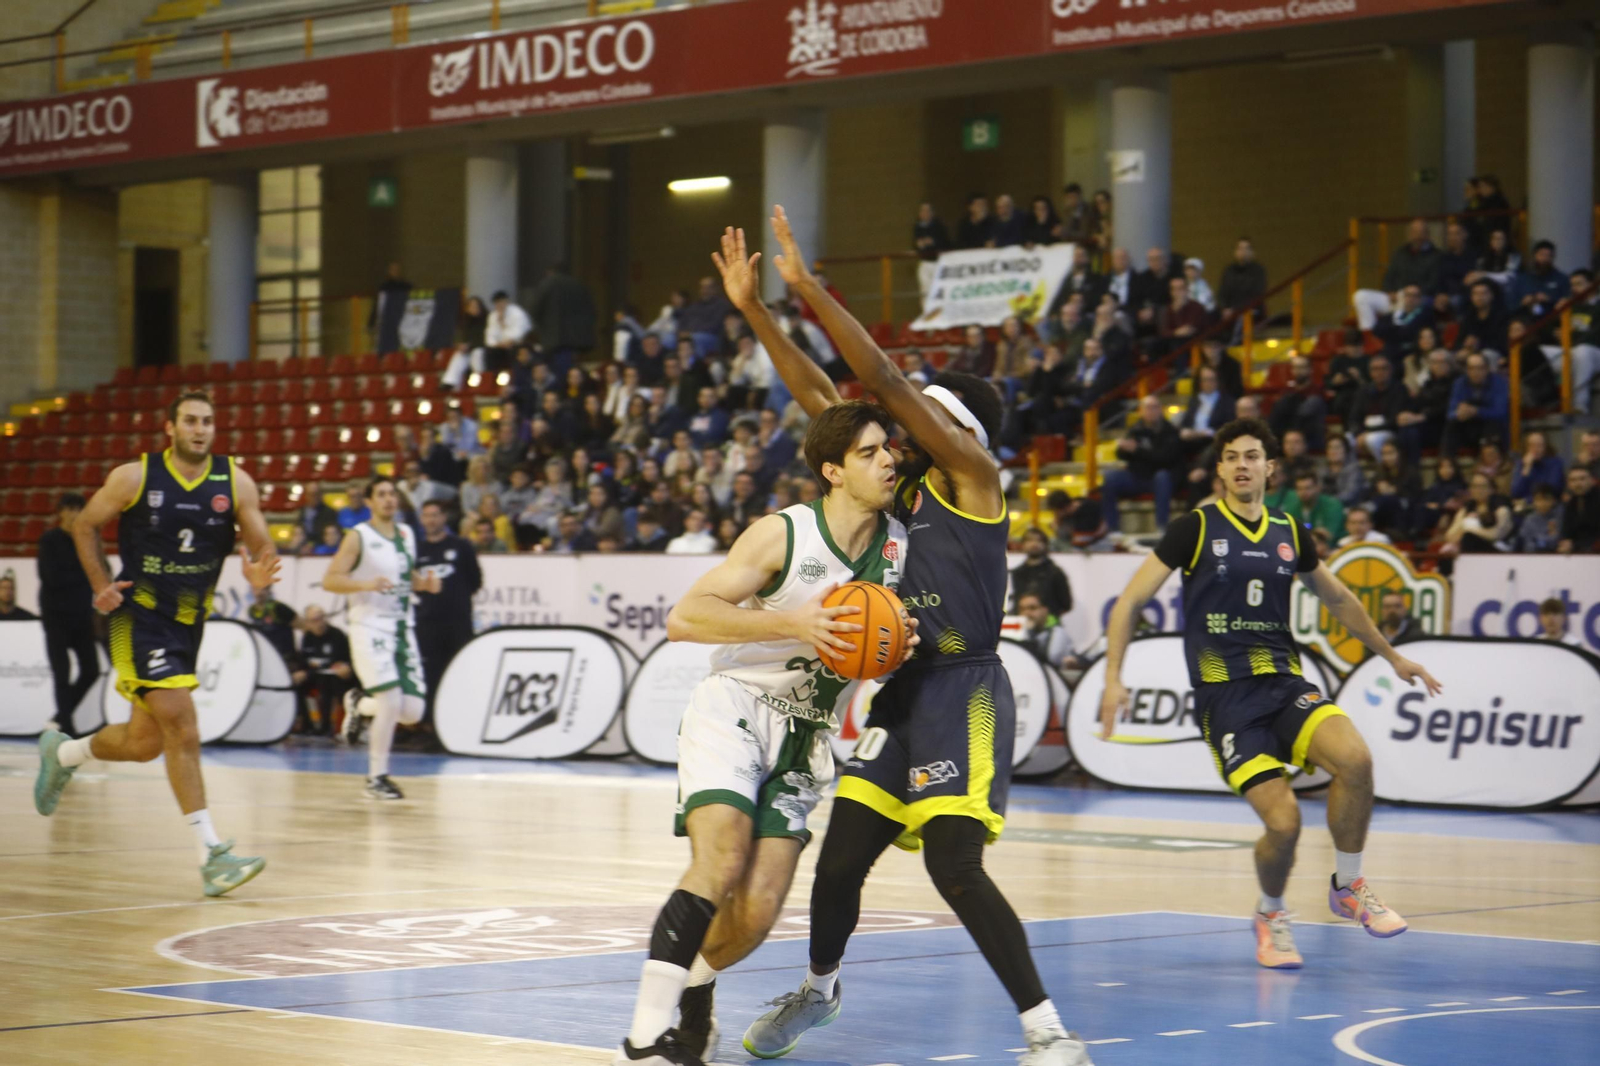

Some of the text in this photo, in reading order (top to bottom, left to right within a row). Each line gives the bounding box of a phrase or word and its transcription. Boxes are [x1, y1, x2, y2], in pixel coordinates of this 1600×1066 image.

[1115, 18, 1187, 37] Municipal
[1190, 14, 1210, 29] de
[1212, 5, 1286, 28] Deportes
[478, 20, 654, 90] IMDECO
[16, 95, 132, 145] IMDECO
[939, 257, 1042, 280] BIENVENIDO
[177, 528, 196, 553] 2
[1246, 578, 1264, 607] 6
[1390, 691, 1582, 760] Sepisur
